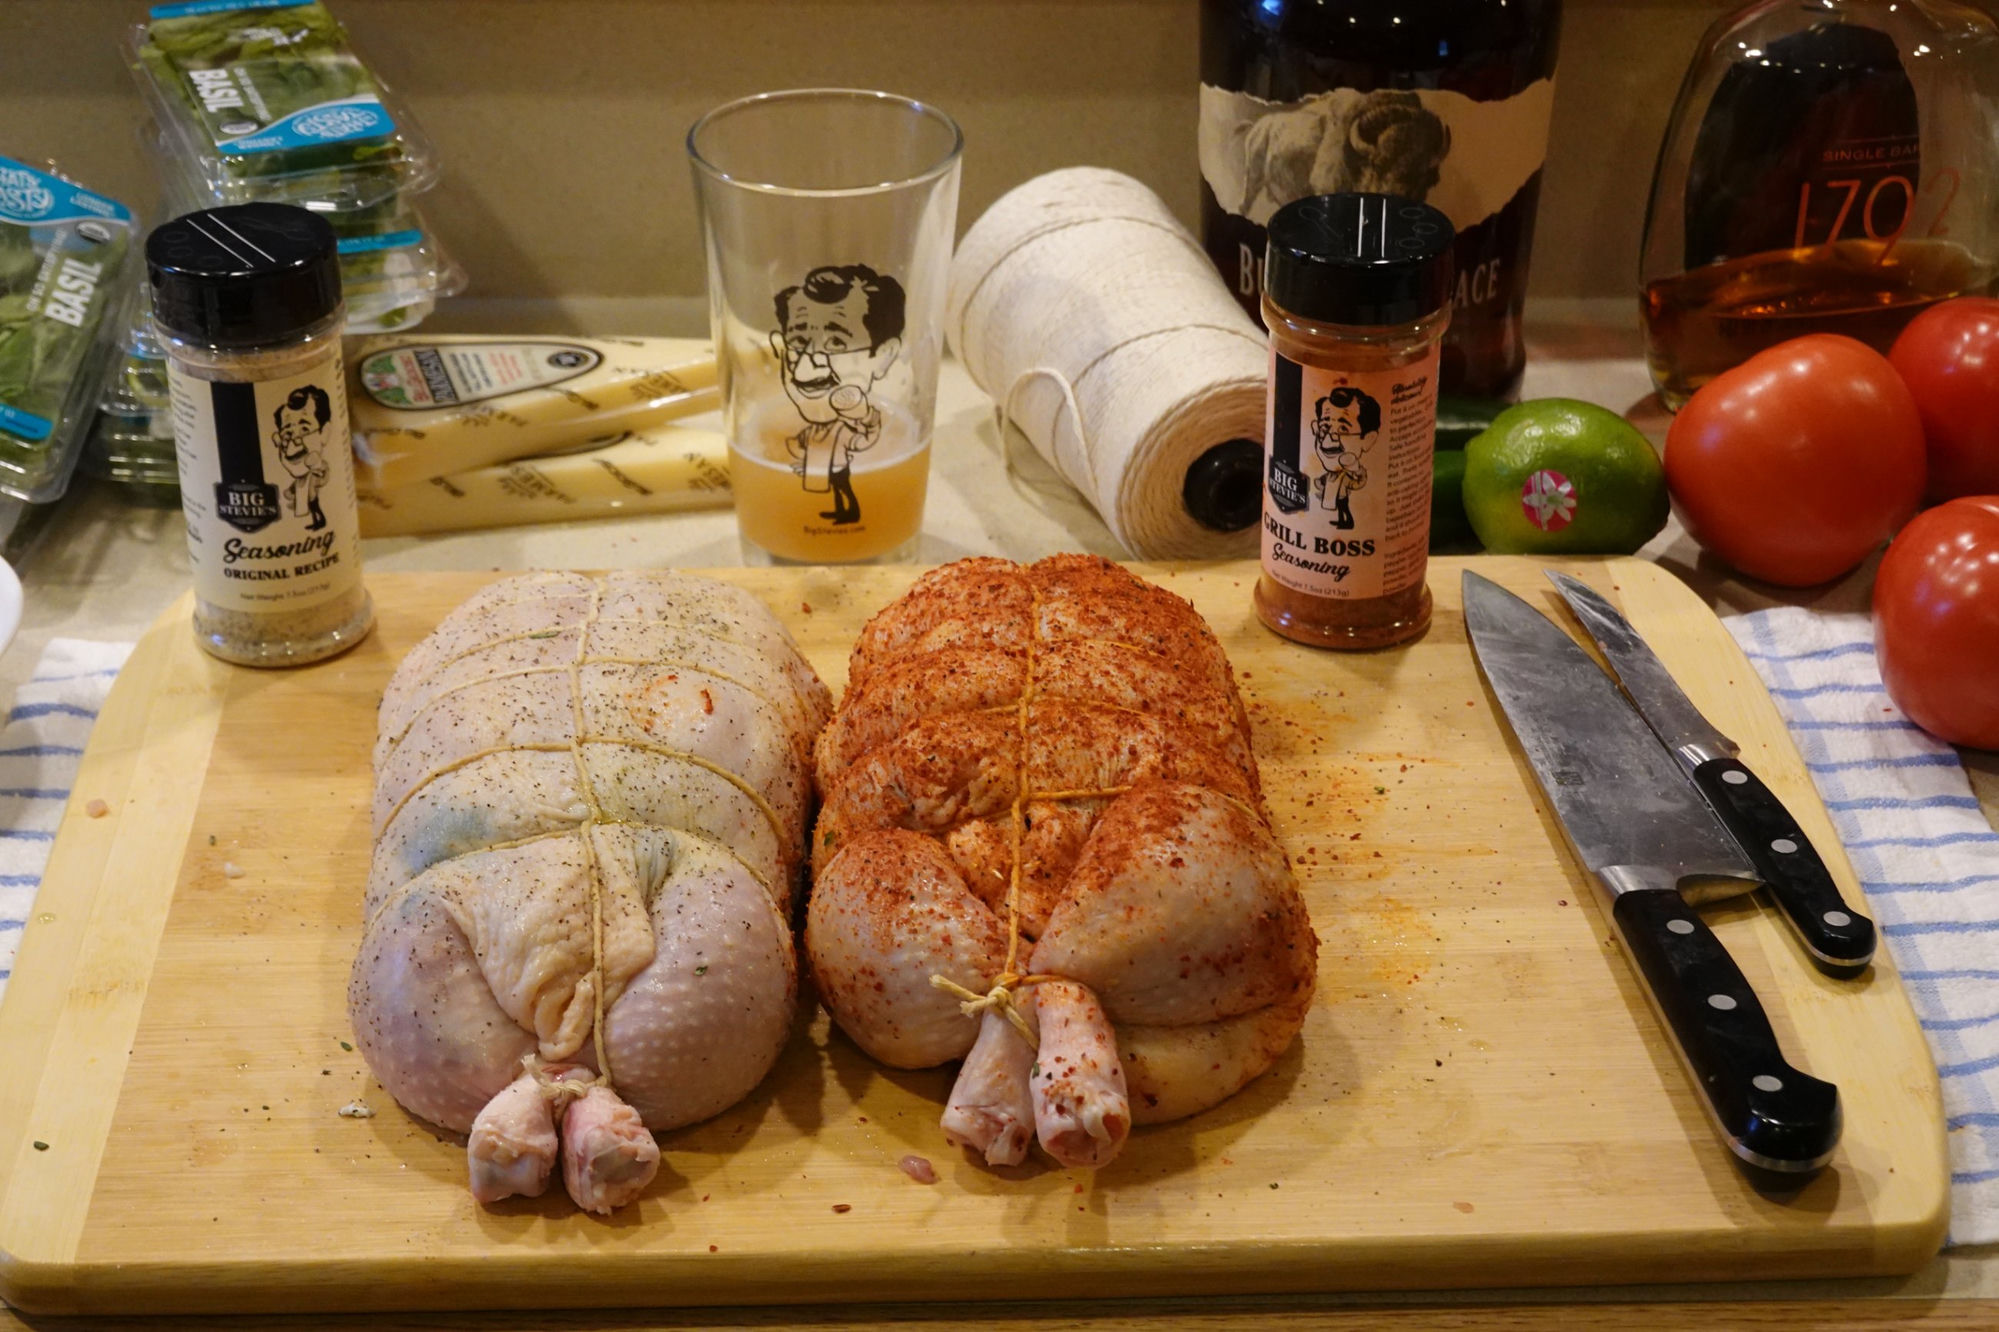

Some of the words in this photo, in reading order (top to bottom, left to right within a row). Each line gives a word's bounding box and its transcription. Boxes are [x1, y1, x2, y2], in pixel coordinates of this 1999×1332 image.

[189, 69, 244, 113] BASIL
[1822, 147, 1885, 163] SINGLE
[44, 257, 104, 327] BASIL
[1450, 257, 1499, 309] ACE
[1269, 479, 1307, 505] STEVIE'S
[1274, 467, 1298, 492] BIG
[220, 504, 277, 517] STEVIE'S
[228, 491, 265, 506] BIG
[223, 530, 336, 564] Seasoning
[1264, 511, 1307, 550] GRILL
[1314, 536, 1376, 557] BOSS
[223, 567, 290, 581] ORIGINAL
[294, 552, 340, 577] RECIPE
[1272, 542, 1350, 583] Seasoning
